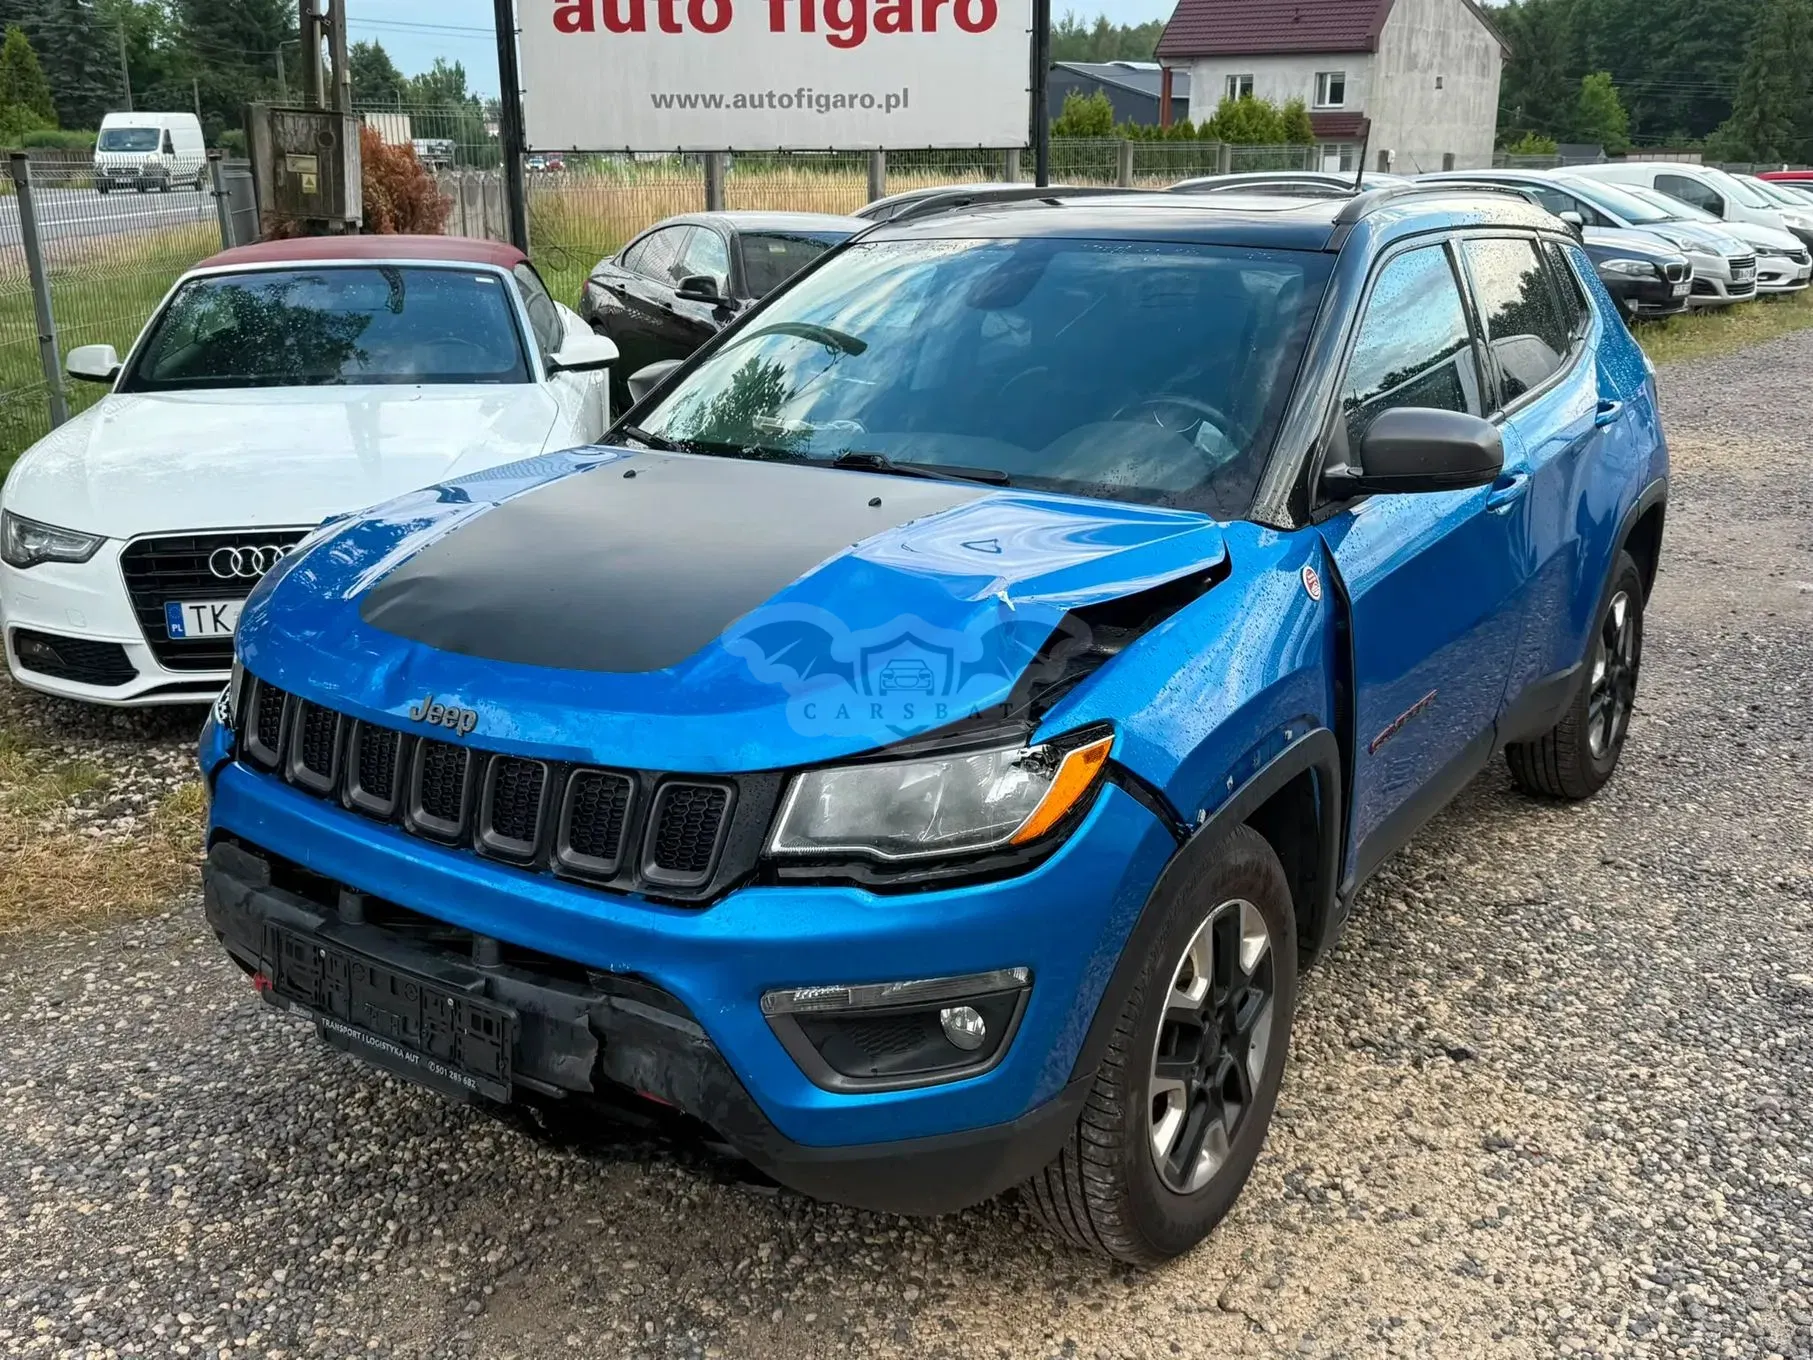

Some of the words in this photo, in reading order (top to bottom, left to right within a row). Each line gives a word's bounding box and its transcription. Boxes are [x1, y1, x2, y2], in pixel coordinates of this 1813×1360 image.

[553, 0, 733, 34] auto
[762, 0, 998, 49] figaro
[651, 88, 909, 114] www.autofigaro.pl
[171, 624, 183, 632] PL
[410, 695, 478, 737] Jeep
[321, 1017, 362, 1040] TRANSPORT
[366, 1035, 404, 1058] LOGISTYKA
